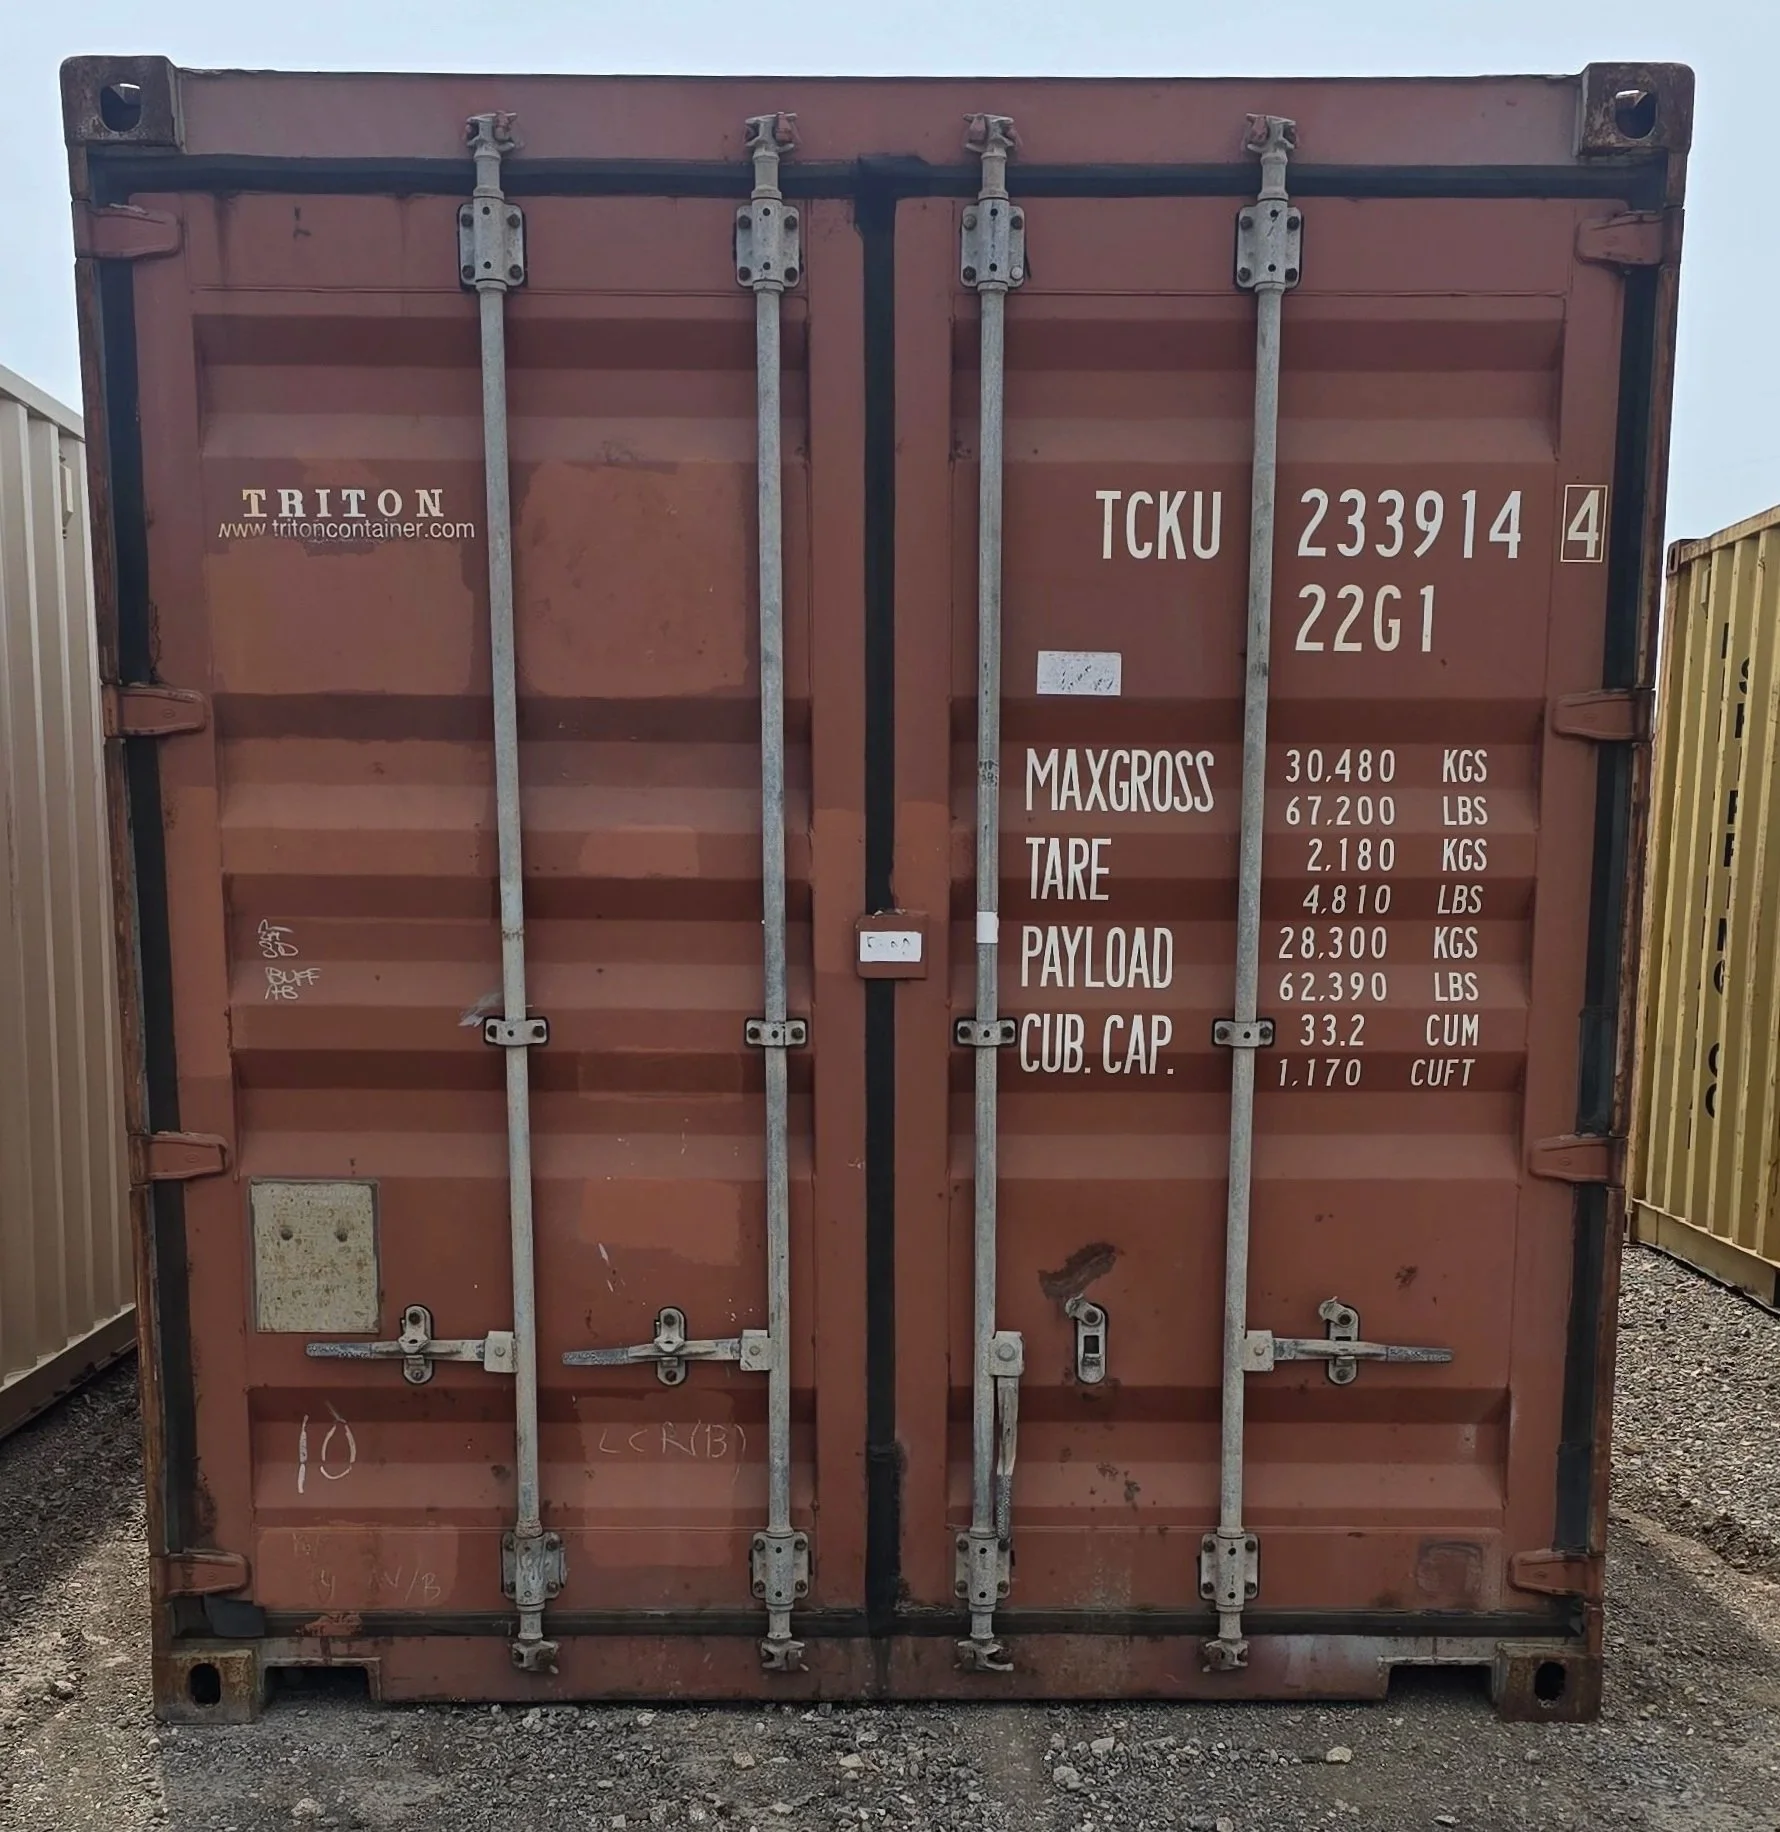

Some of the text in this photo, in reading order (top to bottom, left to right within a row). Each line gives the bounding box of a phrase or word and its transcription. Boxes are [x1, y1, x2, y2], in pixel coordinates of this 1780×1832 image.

[242, 489, 444, 518] TRITON
[1096, 488, 1600, 560] TCKU 233914 4
[1295, 584, 1435, 652] 22G1
[1025, 748, 1214, 813] MAXGROSS
[1285, 749, 1395, 783] 30,480
[1442, 749, 1488, 783] KGS
[1286, 796, 1488, 826] 67,200 LBS
[1026, 837, 1487, 901] TARE 2,180 KGS
[1302, 884, 1484, 915] 4,810 LBS
[1021, 926, 1478, 989] PAYLOAD 28,300 KGS
[1279, 972, 1479, 1002] 62,390 LBS
[1020, 1014, 1480, 1075] CUB. CAP. 33.2 CUM
[1279, 1058, 1476, 1087] 1,170 CUFT
[297, 1413, 357, 1494] 10
